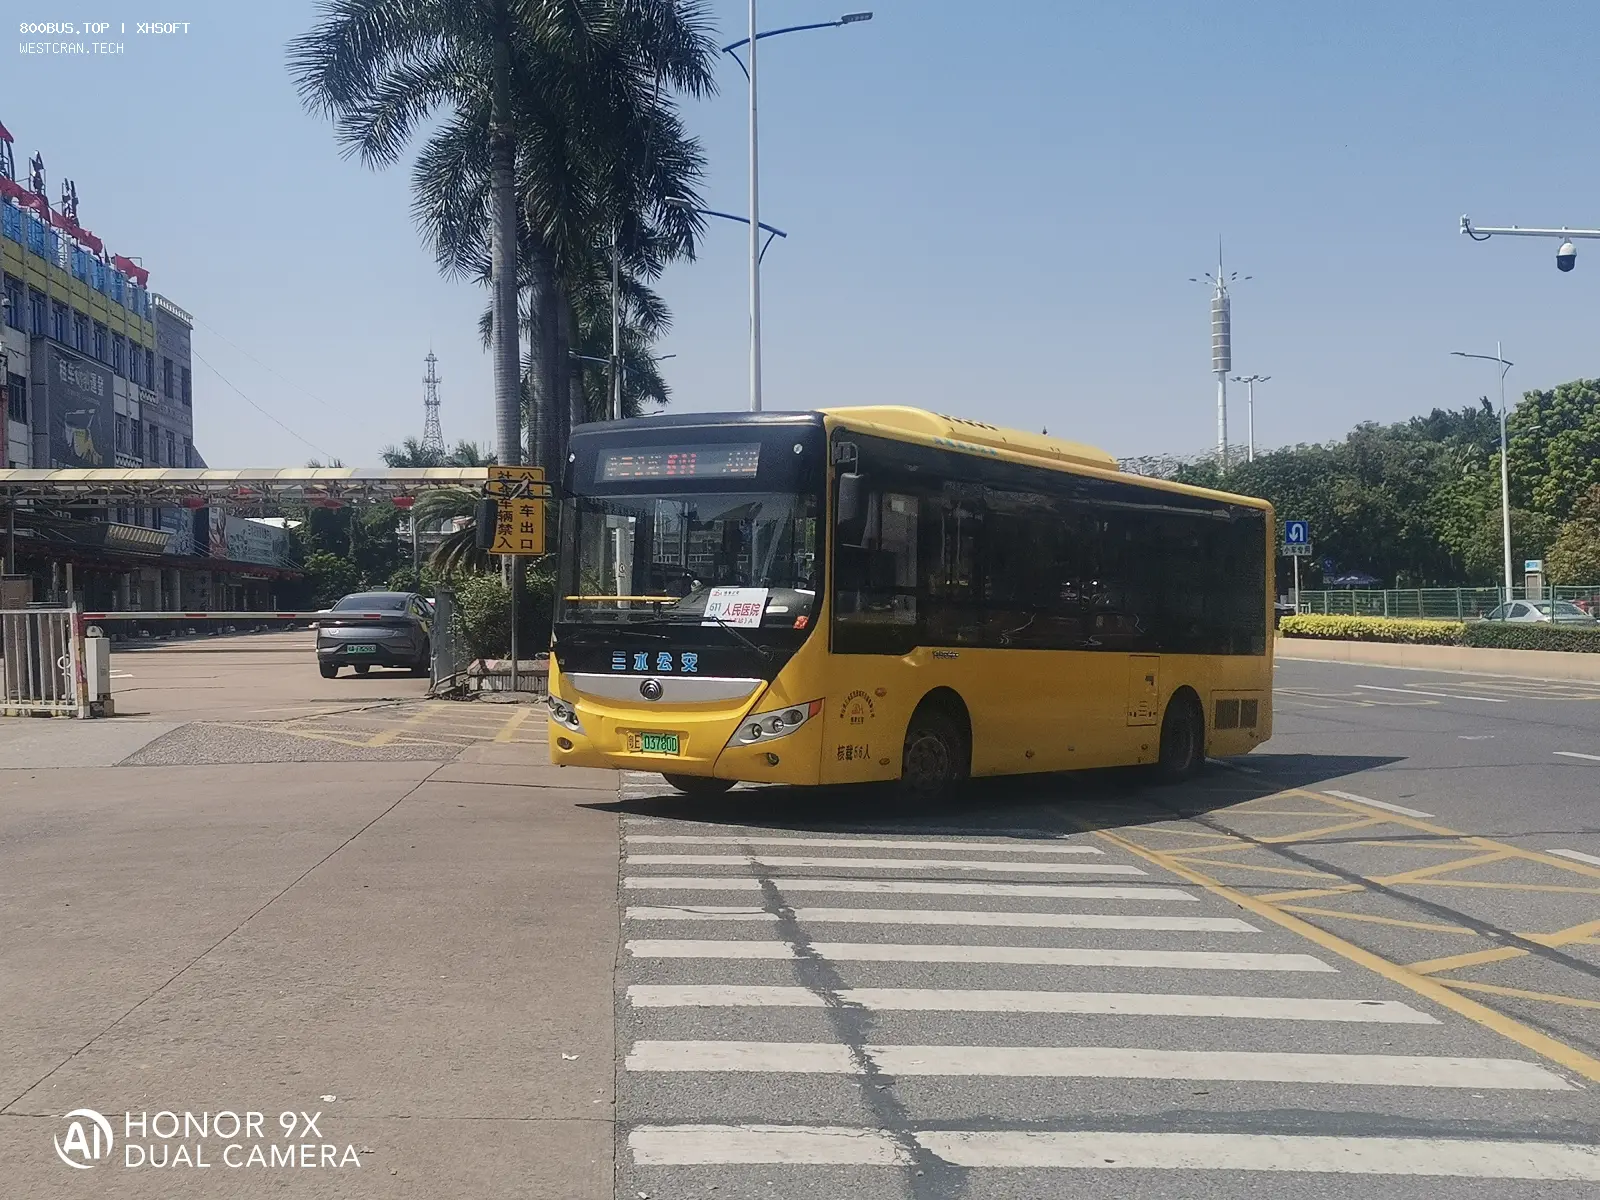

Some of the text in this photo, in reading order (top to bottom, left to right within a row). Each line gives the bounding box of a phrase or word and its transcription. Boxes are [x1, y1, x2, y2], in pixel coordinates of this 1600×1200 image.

[722, 602, 761, 617] 人民医院
[612, 651, 698, 673] 三水公交
